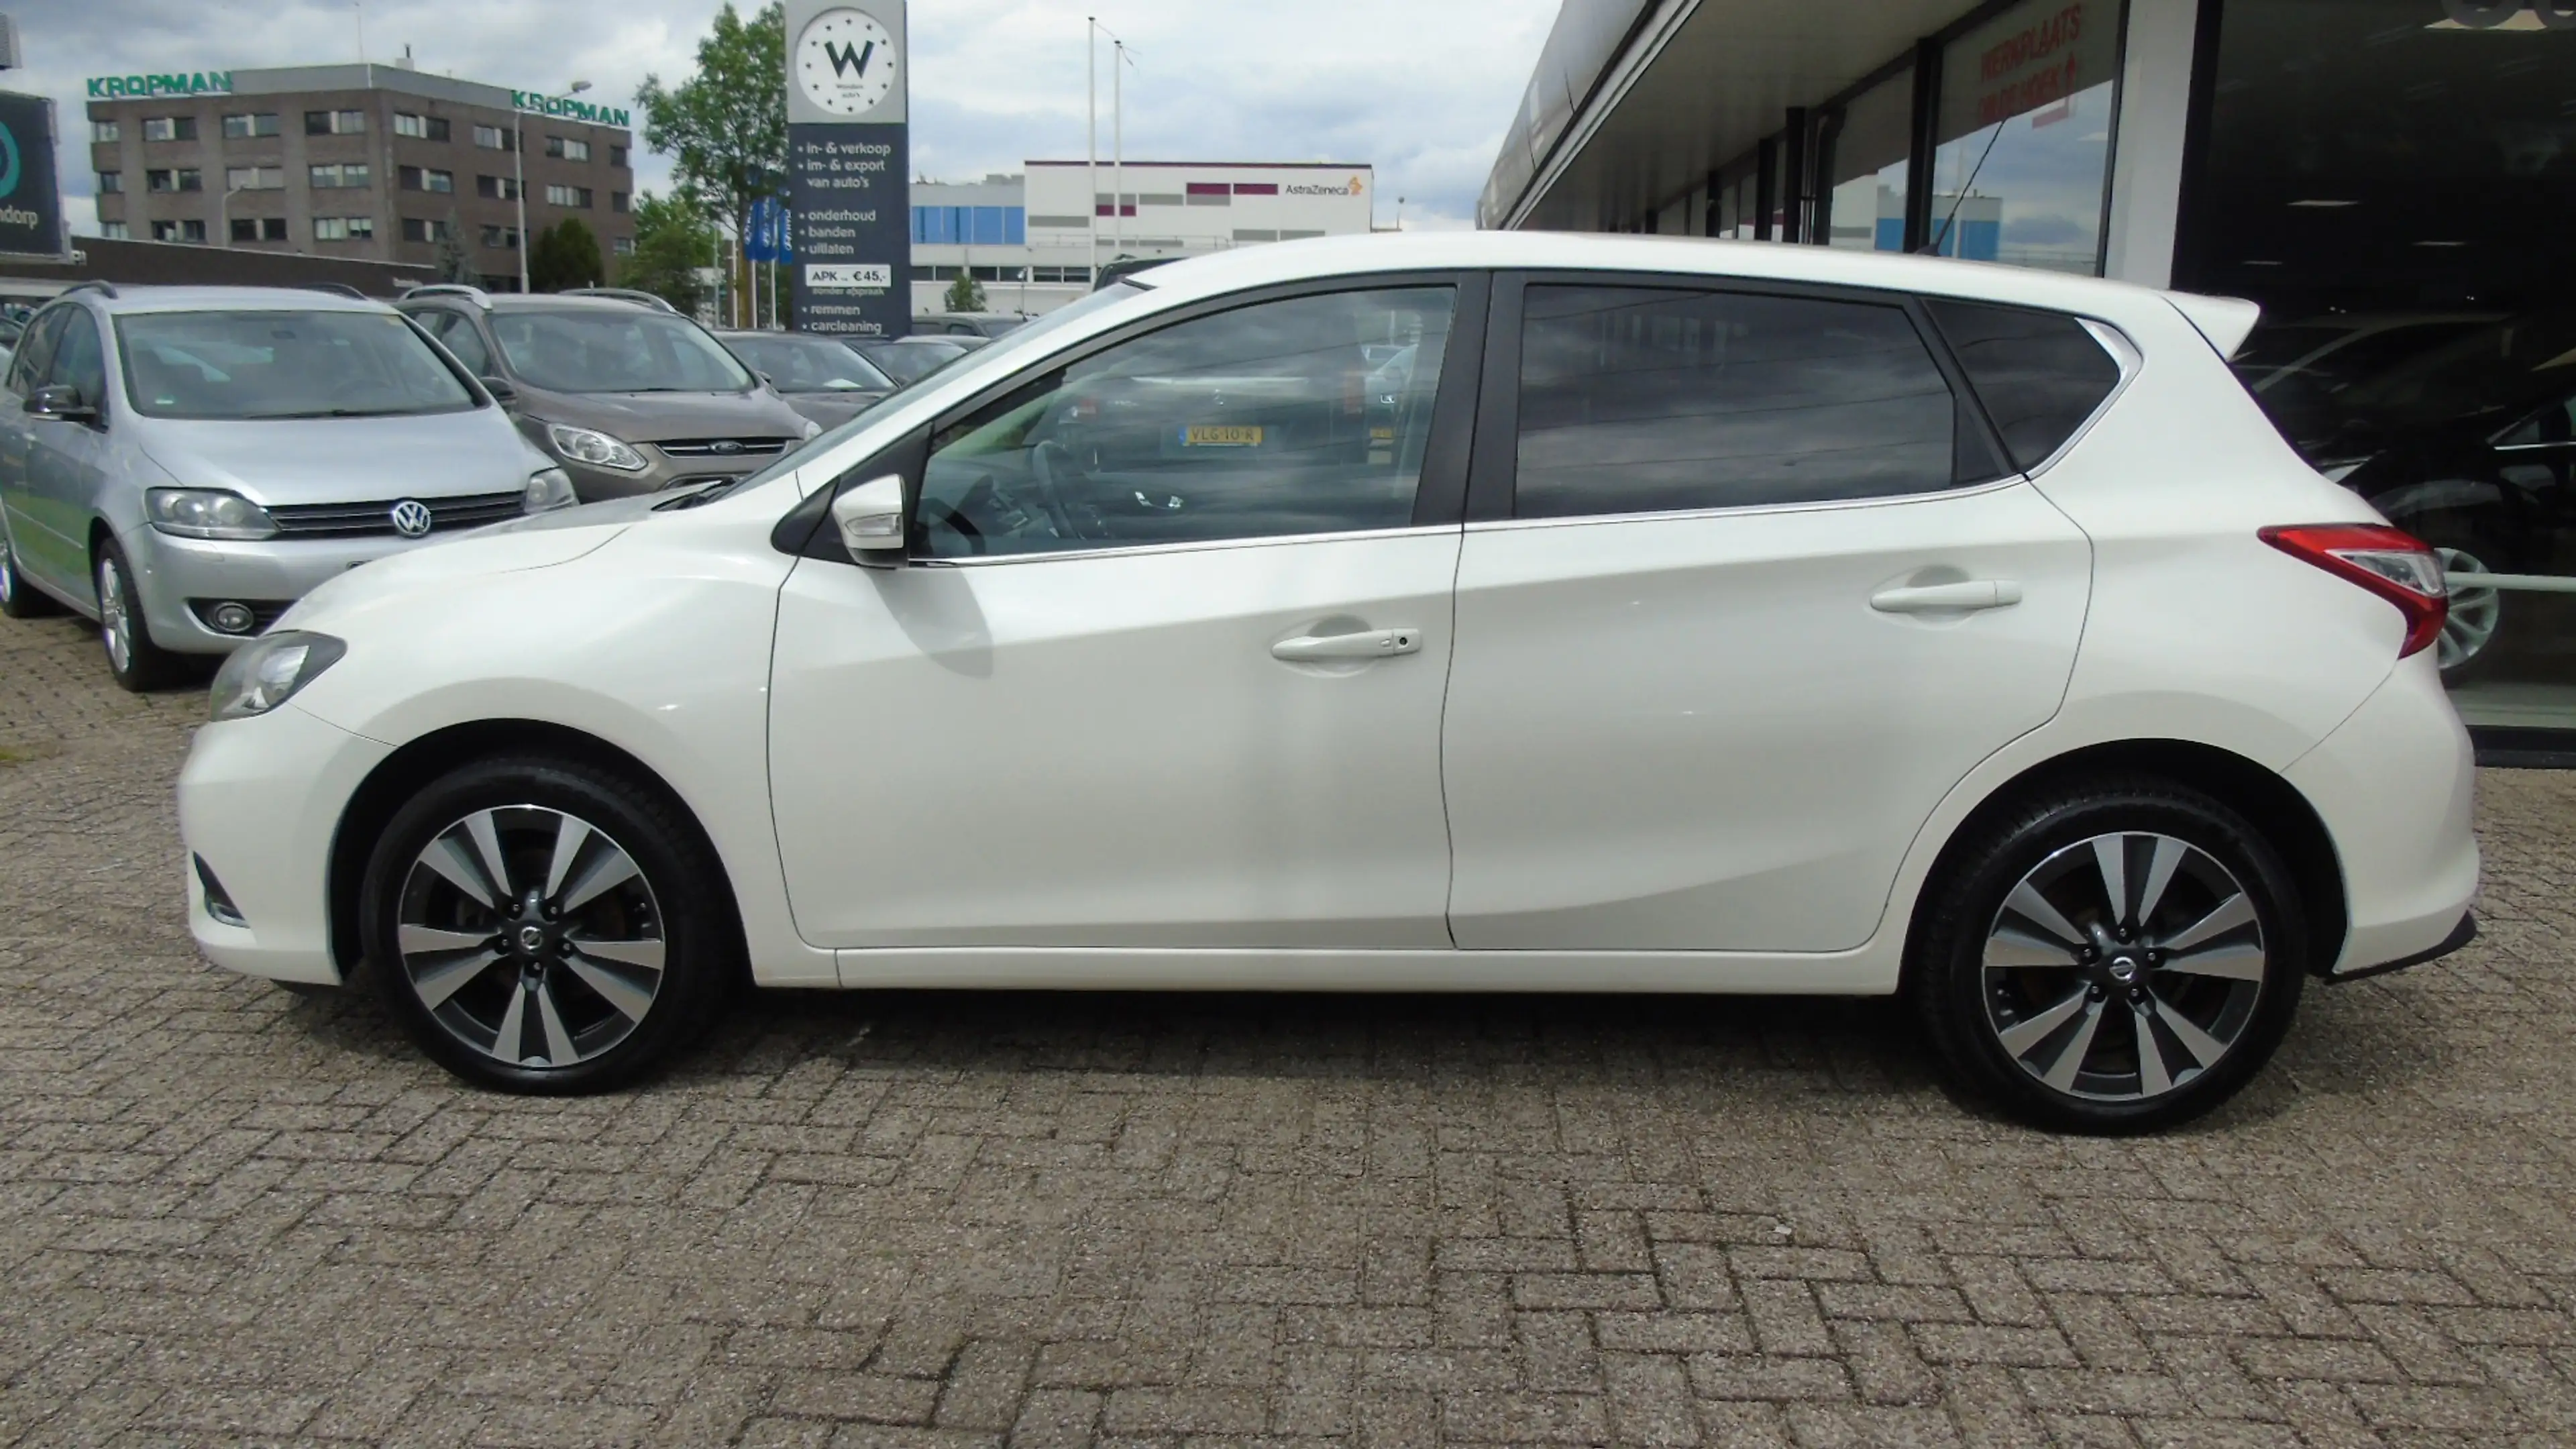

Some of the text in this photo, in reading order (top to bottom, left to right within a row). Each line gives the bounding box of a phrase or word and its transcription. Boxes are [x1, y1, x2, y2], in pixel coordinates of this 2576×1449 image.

[824, 40, 875, 79] W
[87, 70, 232, 98] KROPMAN
[511, 89, 629, 127] KROPMAN
[807, 141, 892, 157] in- & verkoop
[807, 158, 885, 174] im- & export
[807, 175, 869, 188] van auto's
[1286, 184, 1349, 195] AstraZeneca
[808, 209, 876, 221] onderhoud
[808, 225, 856, 237] banden
[808, 242, 854, 254] uitlaten
[812, 271, 837, 281] APK
[810, 305, 860, 315] remmen
[811, 320, 882, 335] carcleaning
